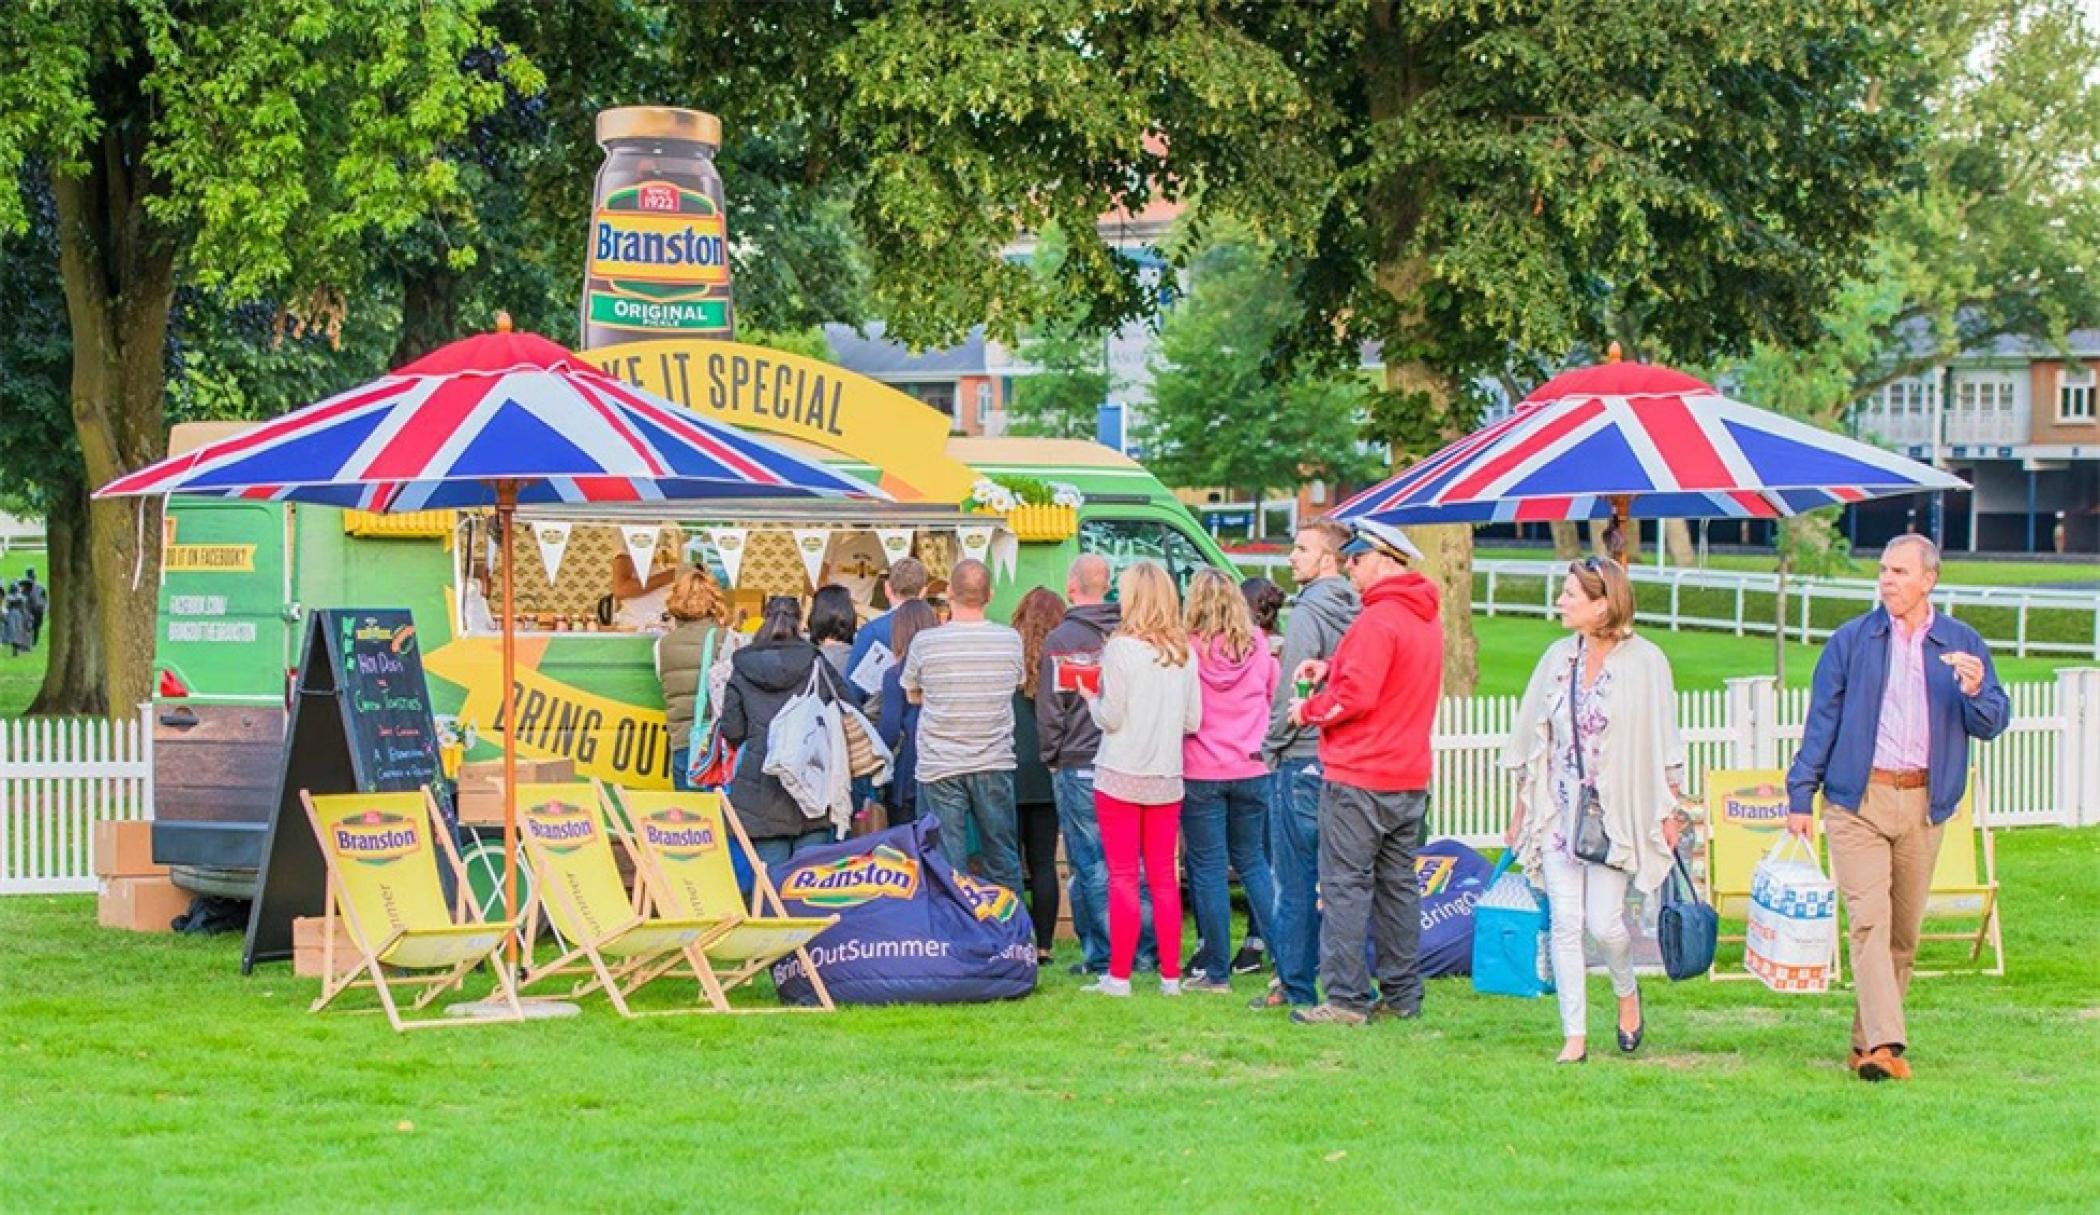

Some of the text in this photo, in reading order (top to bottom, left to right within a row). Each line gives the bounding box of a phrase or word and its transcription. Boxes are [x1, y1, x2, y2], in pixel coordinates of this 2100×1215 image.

[596, 222, 724, 266] Branston
[613, 299, 708, 321] ORIGINAL
[659, 352, 692, 410] IT
[709, 353, 843, 436] SPECIAL
[336, 829, 417, 850] Branston
[528, 817, 593, 840] Branston
[646, 825, 713, 846] Branston
